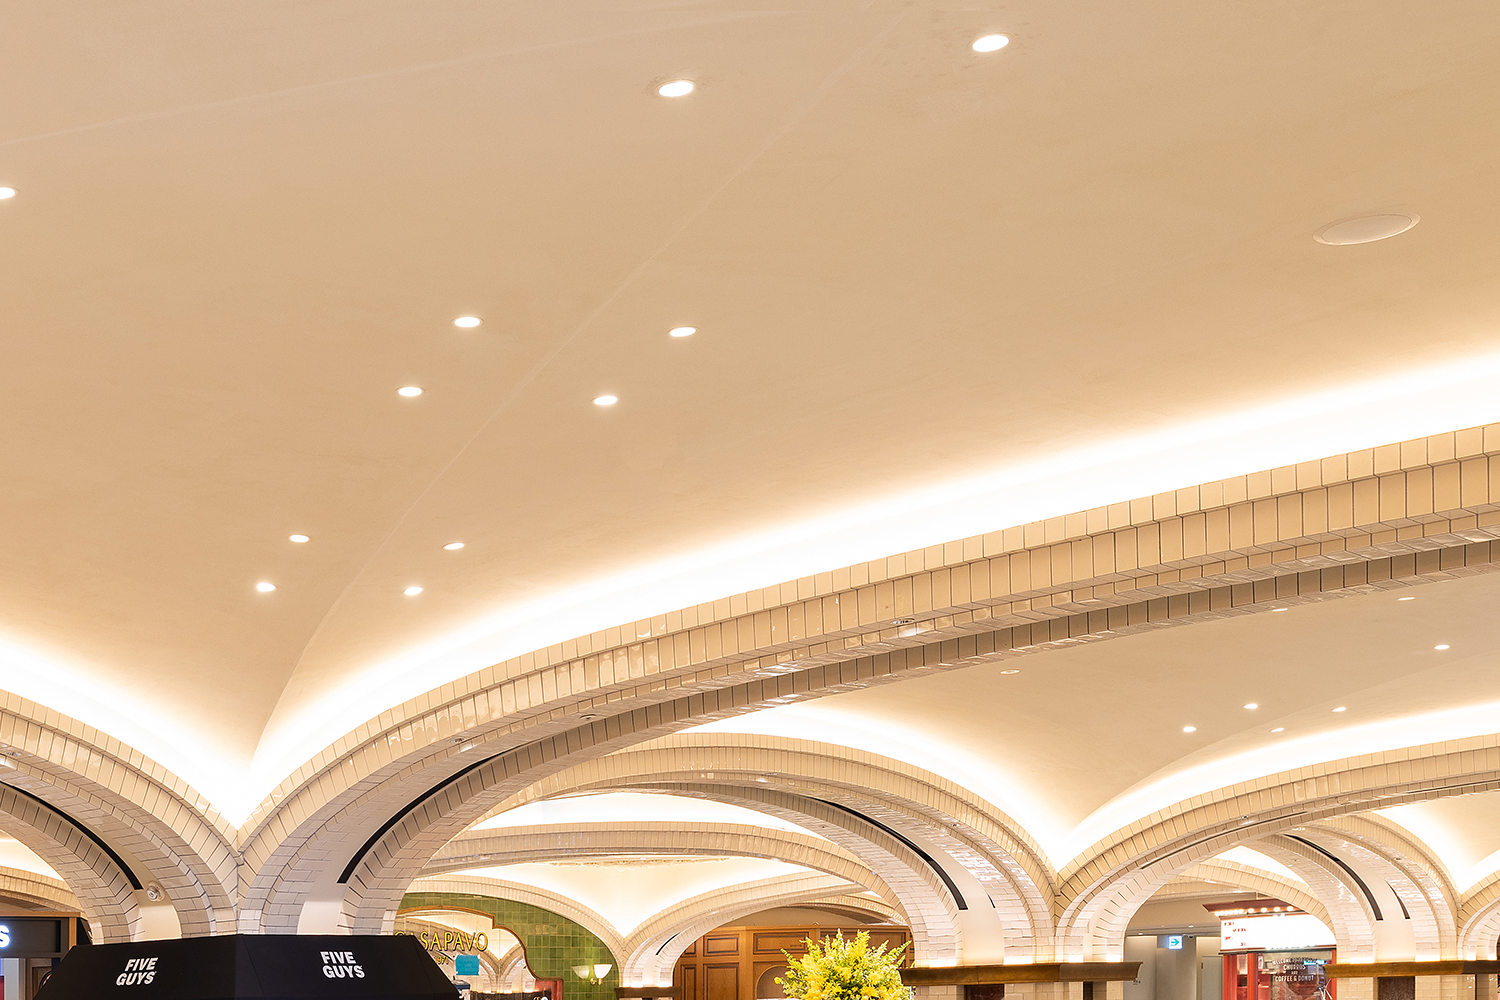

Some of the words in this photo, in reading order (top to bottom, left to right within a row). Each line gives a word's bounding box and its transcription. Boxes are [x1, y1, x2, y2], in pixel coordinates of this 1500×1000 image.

[395, 931, 488, 951] SAPAVO
[124, 957, 158, 971] FIVE
[320, 951, 356, 964] FIVE
[116, 971, 156, 986] GUYS
[322, 965, 365, 979] GUYS
